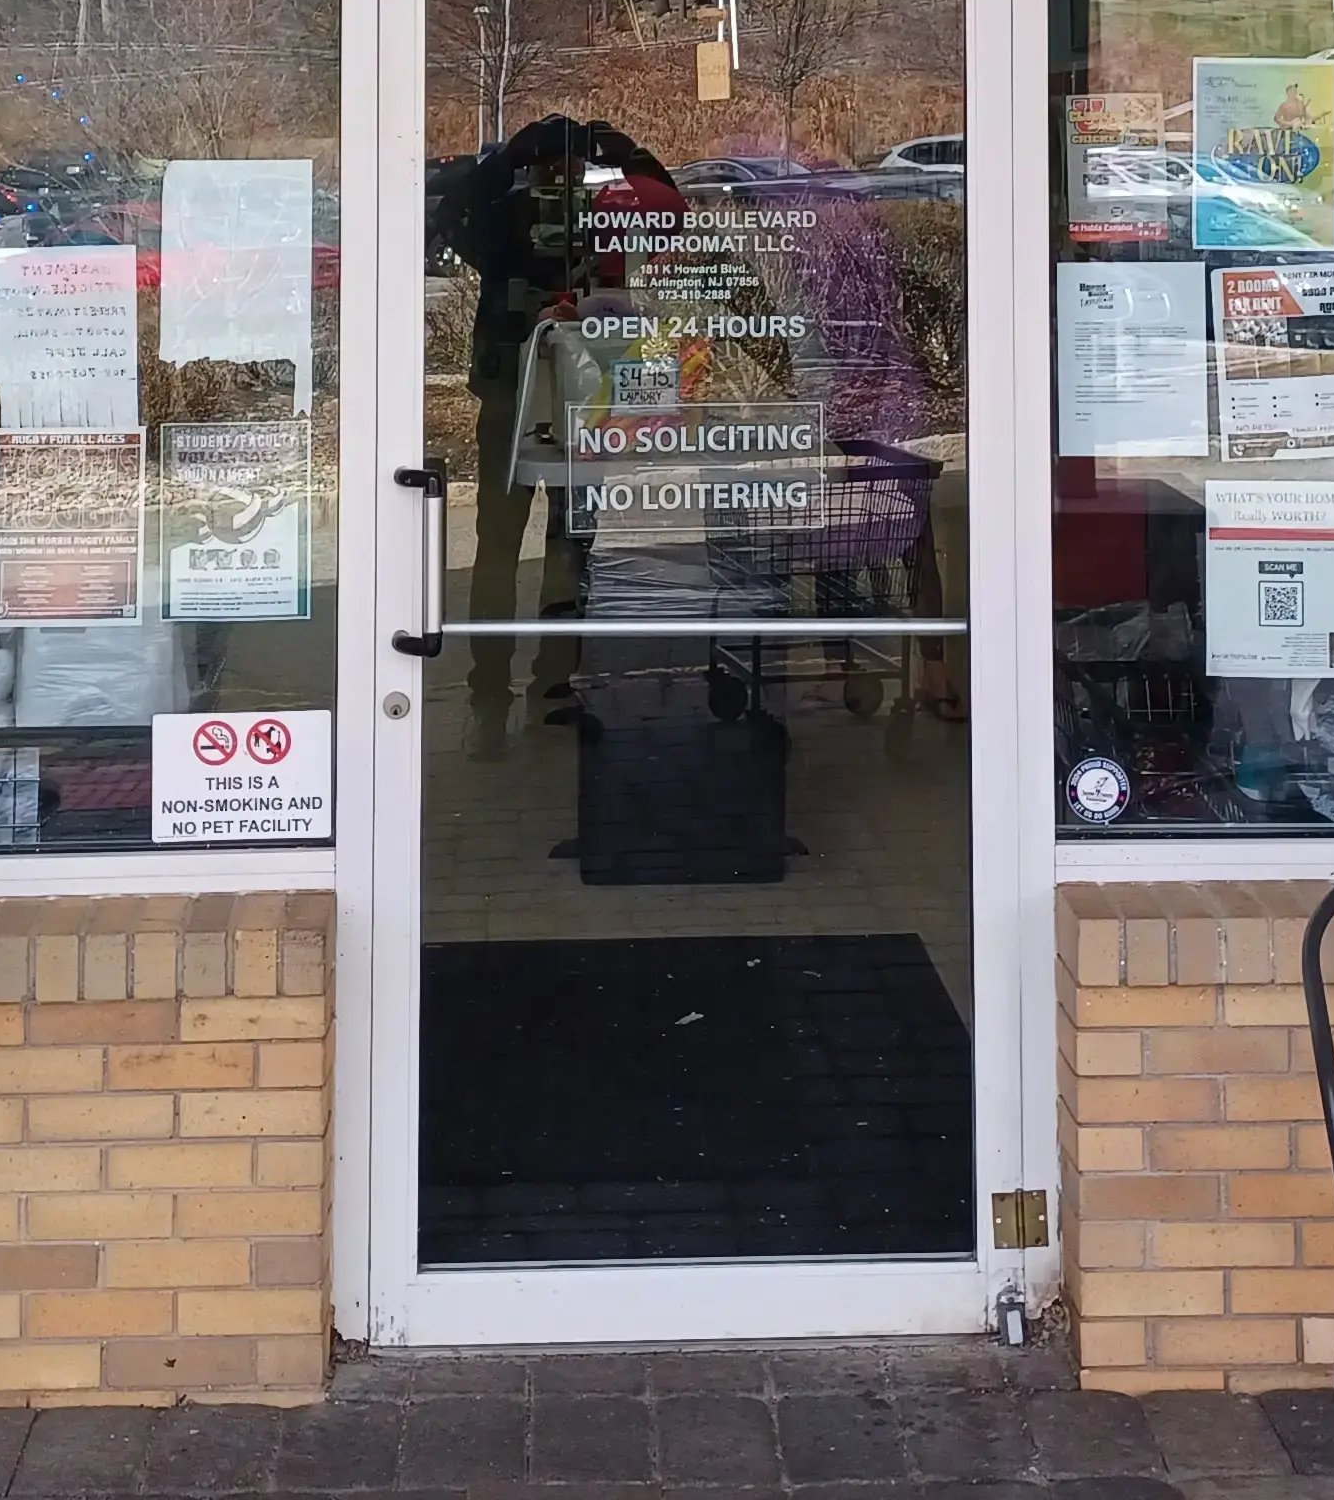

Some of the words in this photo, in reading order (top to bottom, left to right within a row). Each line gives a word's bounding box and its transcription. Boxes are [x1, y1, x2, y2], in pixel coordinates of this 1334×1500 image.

[1228, 128, 1299, 156] RAVE
[1258, 155, 1303, 184] ON!
[578, 211, 676, 229] HOWARD
[682, 210, 817, 229] BOULEVARD
[594, 235, 748, 253] LAUNDROMAT
[754, 235, 801, 252] LLC.
[639, 264, 659, 275] 181
[663, 264, 671, 274] K
[674, 264, 717, 275] Howard
[720, 264, 750, 275] Blvd.
[629, 277, 648, 288] Mt.
[650, 277, 704, 289] Arlington,
[707, 277, 724, 288] NJ
[726, 277, 759, 288] 07856
[1227, 280, 1235, 293] 2
[1237, 279, 1280, 292] ROOMS
[581, 316, 659, 339] OPEN
[668, 317, 698, 338] 24
[707, 316, 806, 338] HOURS
[11, 434, 47, 445] RUGBY
[49, 434, 71, 445] FOR
[71, 434, 95, 445] ALL
[98, 434, 126, 445] AGES
[176, 432, 296, 449] STUDENT/FACULTY
[580, 428, 627, 453] NO
[636, 425, 812, 453] SOLICITING
[177, 466, 262, 481] TOURNAMENT
[586, 485, 633, 510] NO
[642, 482, 807, 509] LOITERING
[1215, 492, 1264, 505] WHAT'S
[1267, 492, 1303, 505] YOUR
[1233, 510, 1268, 523] Really
[1271, 510, 1327, 522] WORTH?
[19, 536, 35, 545] THE
[37, 536, 72, 545] MORRIS
[74, 536, 103, 545] RUGBY
[105, 535, 136, 545] FAMILY
[1264, 563, 1285, 572] SCAN
[1287, 563, 1298, 572] ME
[205, 776, 244, 791] THIS
[248, 776, 264, 790] IS
[267, 775, 280, 790] A
[161, 797, 284, 815] NON-SMOKING
[287, 796, 323, 811] AND
[172, 821, 197, 836] NO
[201, 820, 234, 835] PET
[238, 818, 313, 834] FACILITY
